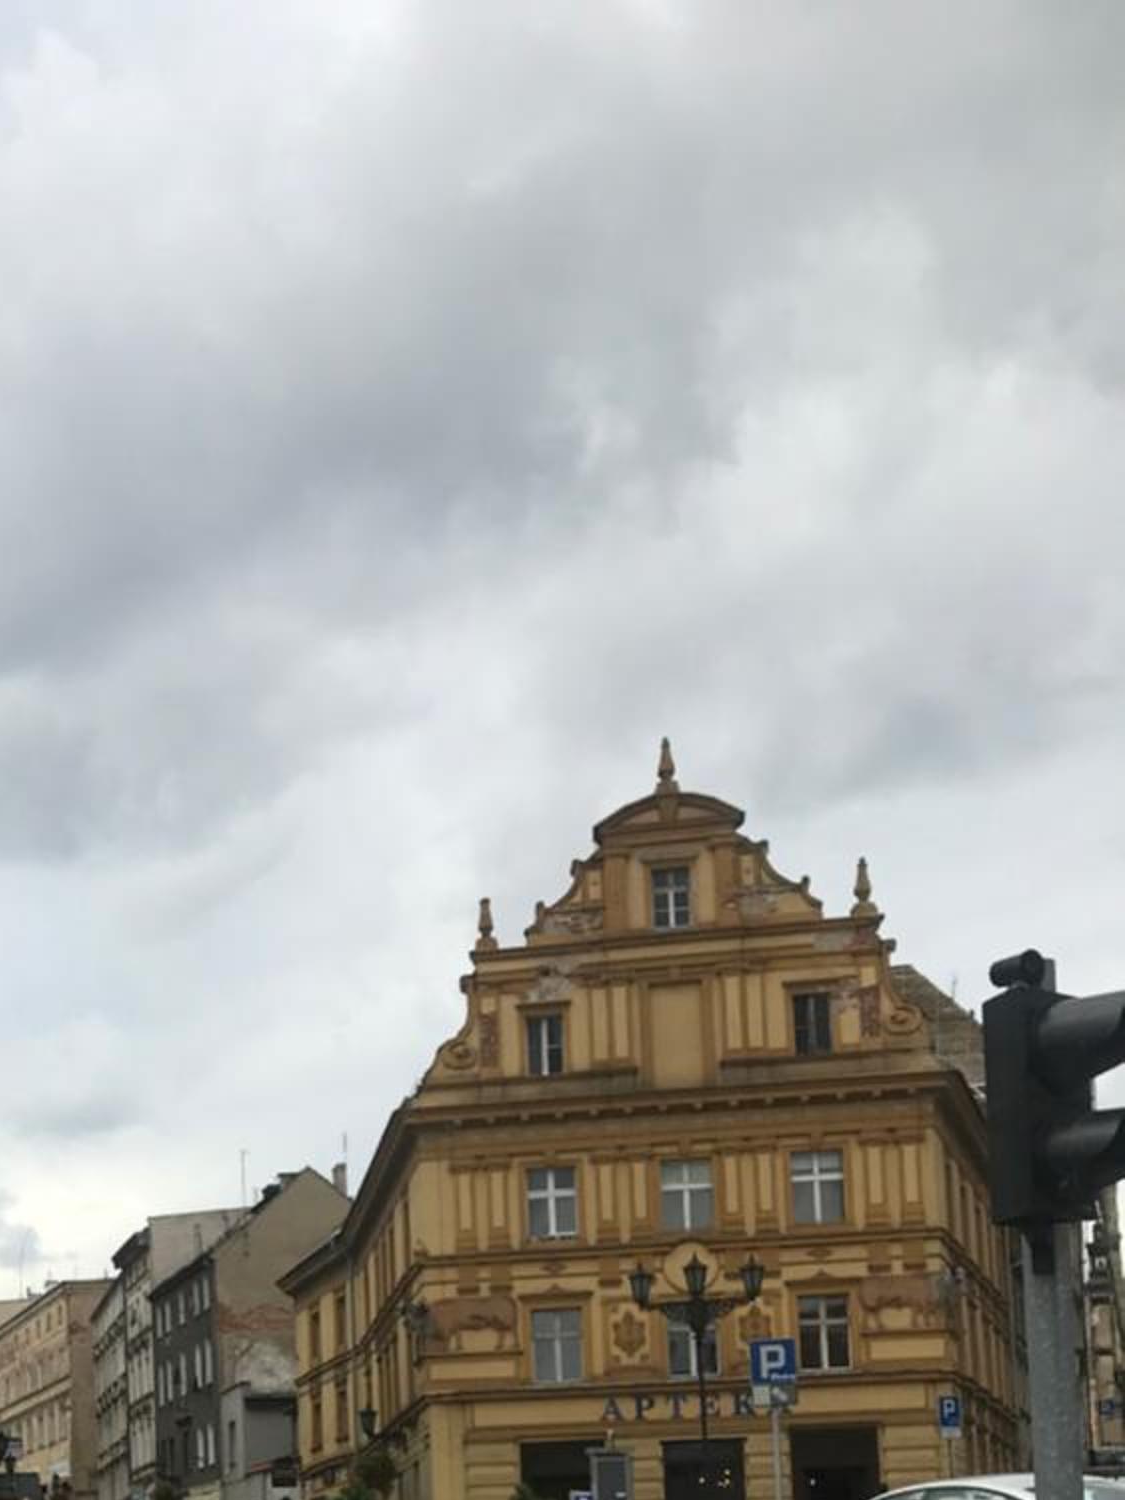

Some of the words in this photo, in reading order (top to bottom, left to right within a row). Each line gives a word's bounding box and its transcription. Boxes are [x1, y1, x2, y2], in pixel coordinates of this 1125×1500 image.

[760, 1344, 786, 1380] P
[603, 1392, 796, 1422] APTEK
[943, 1399, 956, 1418] P
